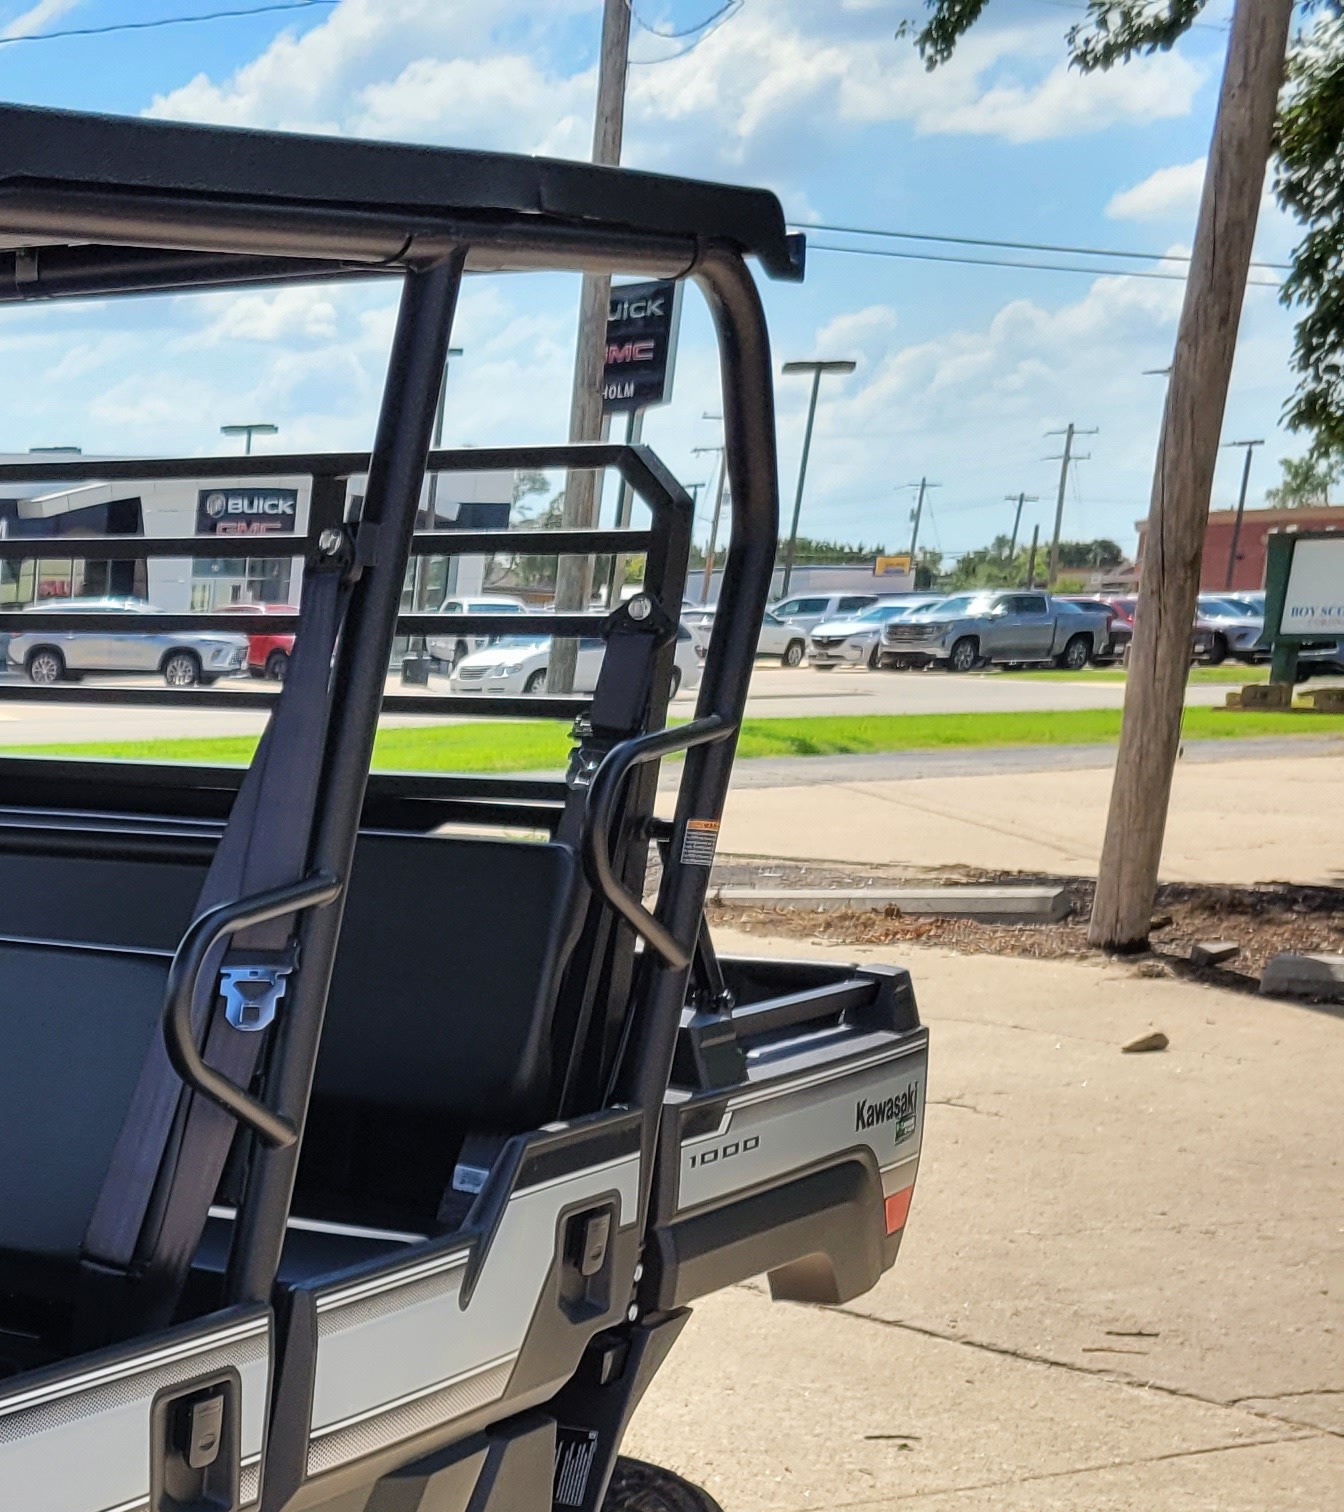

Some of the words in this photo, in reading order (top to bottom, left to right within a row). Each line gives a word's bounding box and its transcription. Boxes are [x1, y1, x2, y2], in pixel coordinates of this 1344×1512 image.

[608, 299, 664, 321] UICK
[227, 496, 294, 515] BUICK
[855, 1081, 919, 1132] Kawasaki
[689, 1135, 760, 1169] 1000
